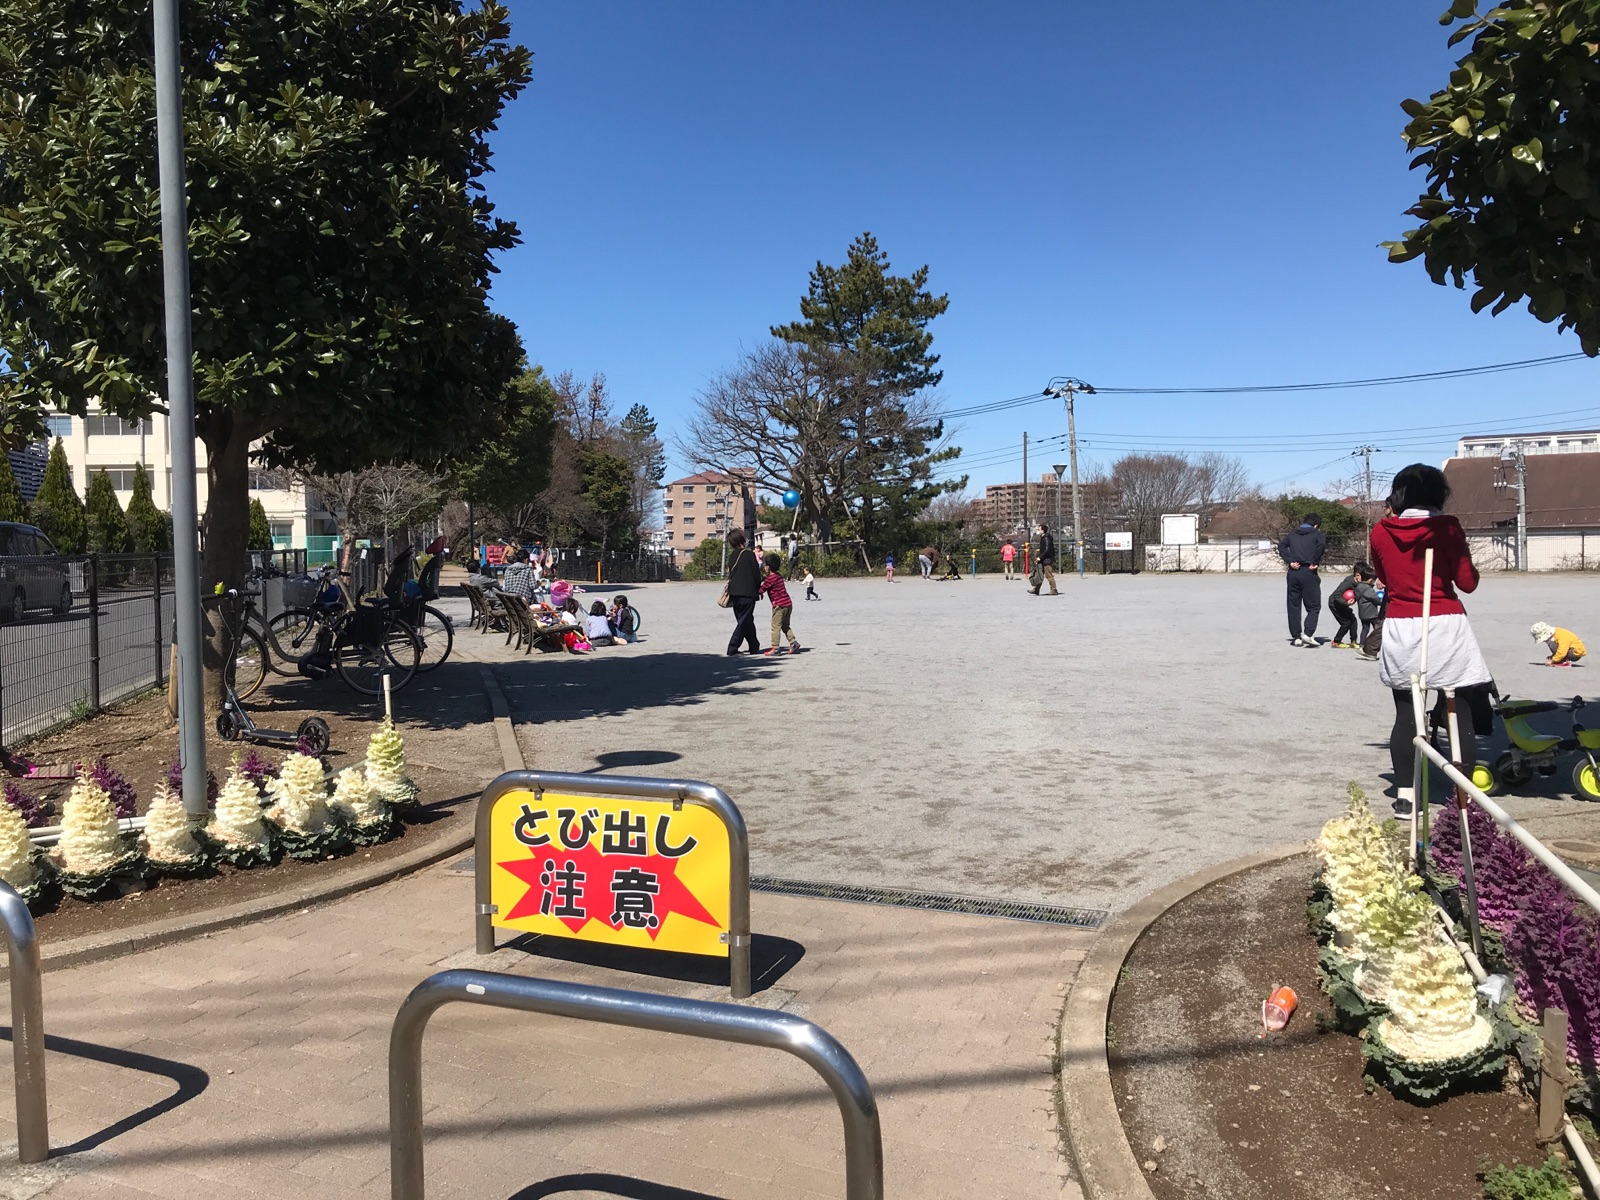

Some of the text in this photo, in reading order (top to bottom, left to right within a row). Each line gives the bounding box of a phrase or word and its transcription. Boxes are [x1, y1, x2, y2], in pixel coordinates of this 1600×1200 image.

[513, 804, 698, 857] とび出し
[540, 859, 660, 929] 注意
